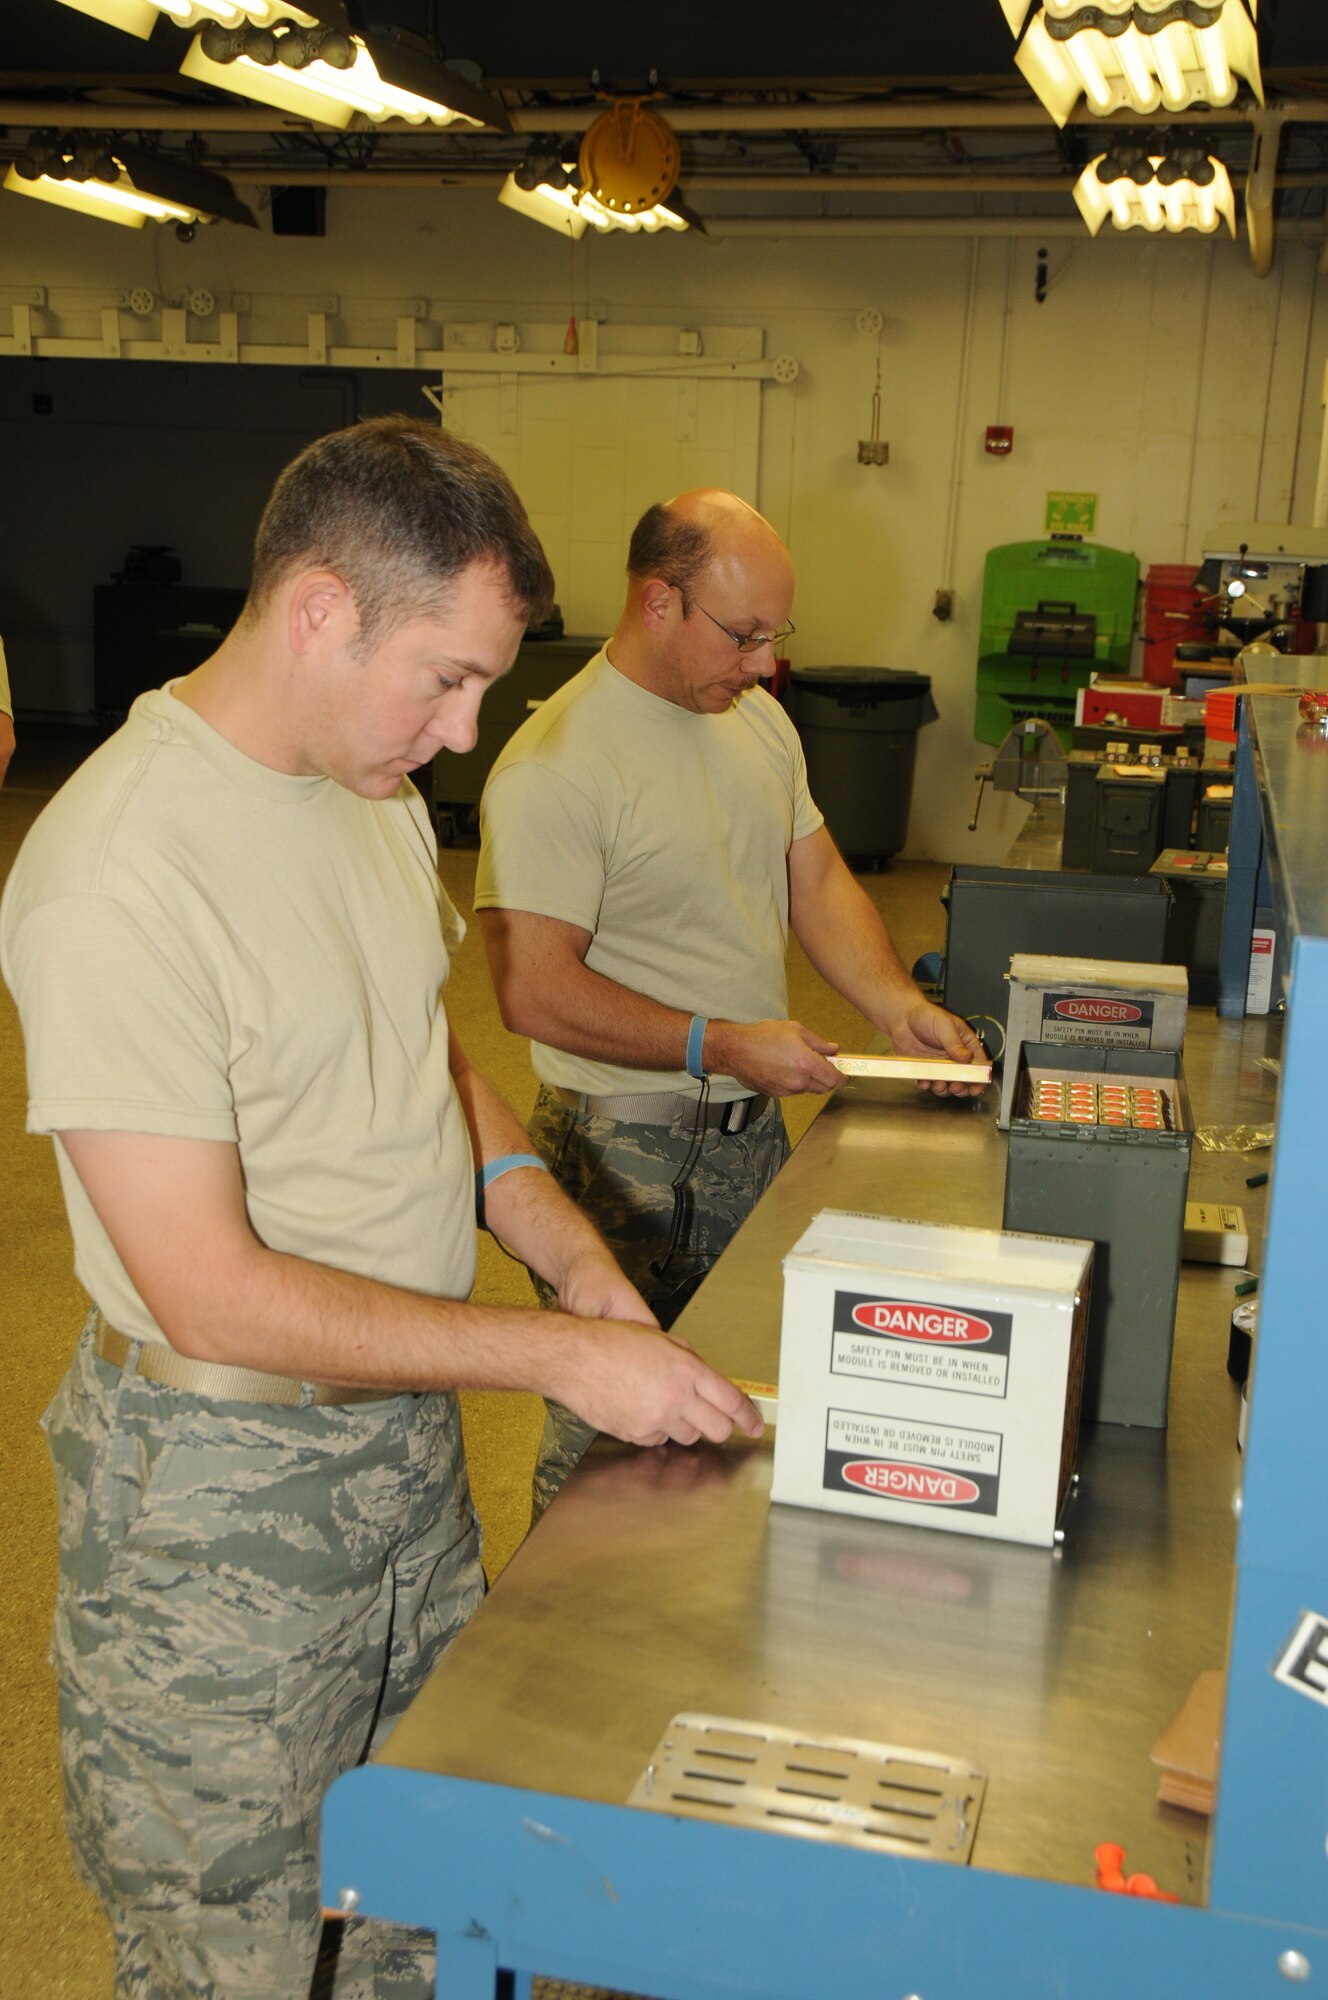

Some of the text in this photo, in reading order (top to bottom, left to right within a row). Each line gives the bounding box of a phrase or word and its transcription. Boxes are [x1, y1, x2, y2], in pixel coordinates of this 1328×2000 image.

[1068, 1003, 1128, 1019] DANGER
[1045, 1033, 1068, 1041] MODULE
[1078, 1036, 1105, 1044] REMOVED
[1116, 1039, 1147, 1048] INSTALLED
[874, 1307, 968, 1339] DANGER
[837, 1354, 1001, 1386] MODULE IS REMOVED OR INSTALLED
[851, 1344, 989, 1373] SAFETY PIN MUST BE IN WHEN
[833, 1420, 995, 1453] MODULE IS REMOVED OR INSTALLED
[844, 1434, 981, 1463] SAFETY PIN MUST BE IN WHEN
[864, 1466, 957, 1499] DANGER
